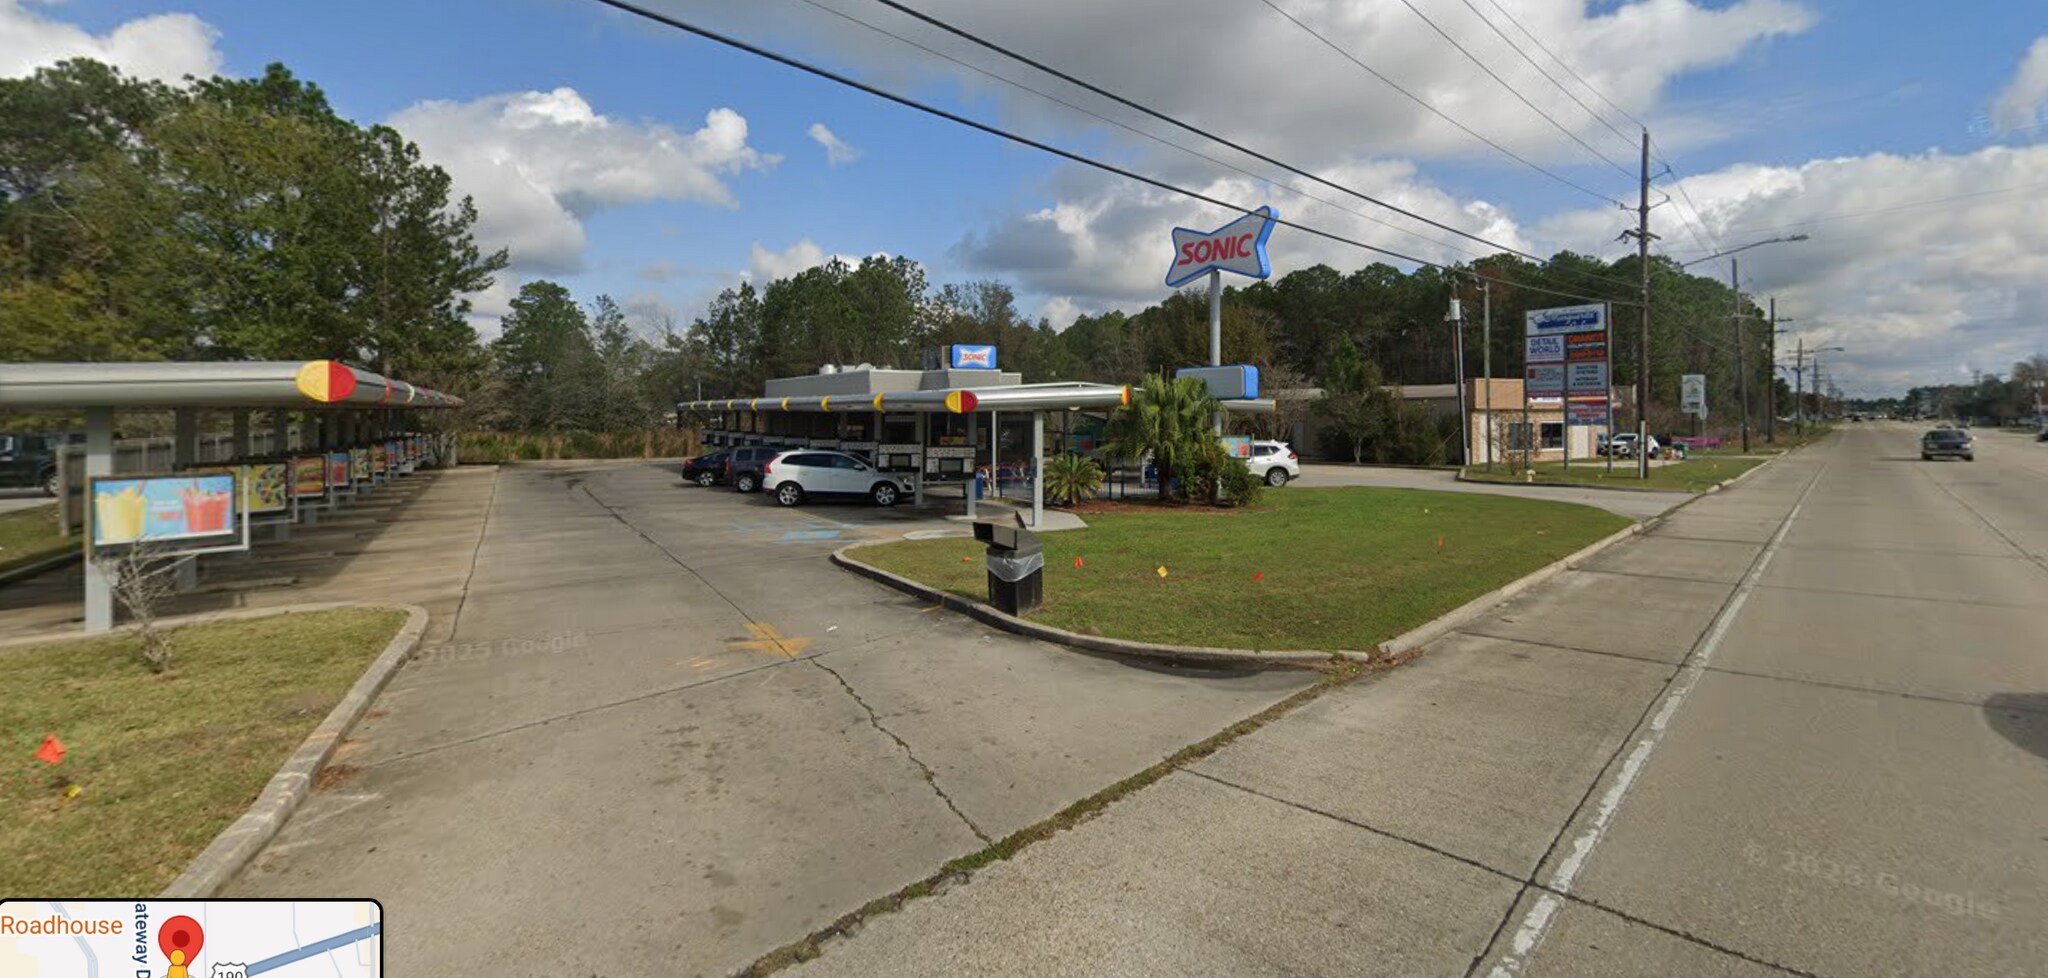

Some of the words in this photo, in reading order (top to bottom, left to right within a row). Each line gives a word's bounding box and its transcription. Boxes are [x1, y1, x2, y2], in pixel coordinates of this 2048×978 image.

[1177, 232, 1253, 266] SONIC
[1530, 337, 1558, 346] DETAIL
[1529, 345, 1561, 354] WORLD
[962, 353, 986, 361] SONIC
